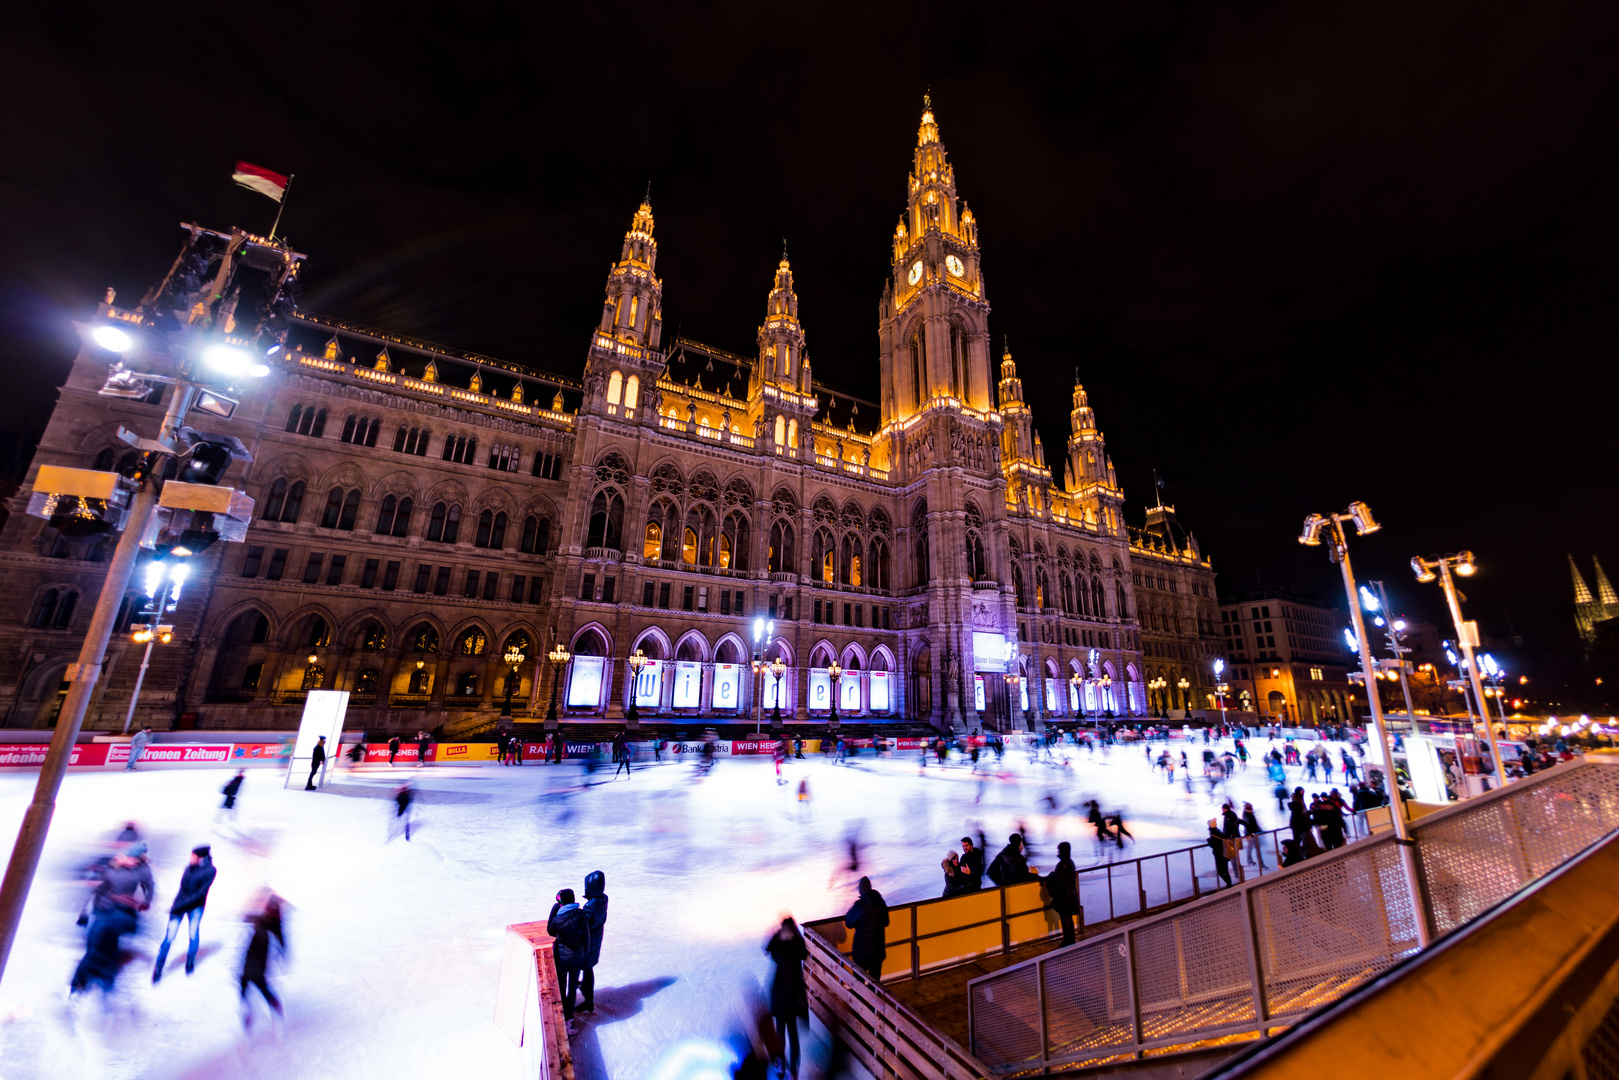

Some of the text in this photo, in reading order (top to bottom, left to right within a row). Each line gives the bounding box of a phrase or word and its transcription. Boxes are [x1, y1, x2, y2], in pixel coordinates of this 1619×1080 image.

[685, 674, 690, 698] i
[721, 681, 731, 700] e
[816, 684, 825, 702] e
[448, 746, 466, 754] BILLA
[567, 745, 595, 753] WIEN
[682, 744, 702, 753] Bank
[737, 742, 759, 750] WIEN
[139, 748, 227, 761] Kronen Zeitung
